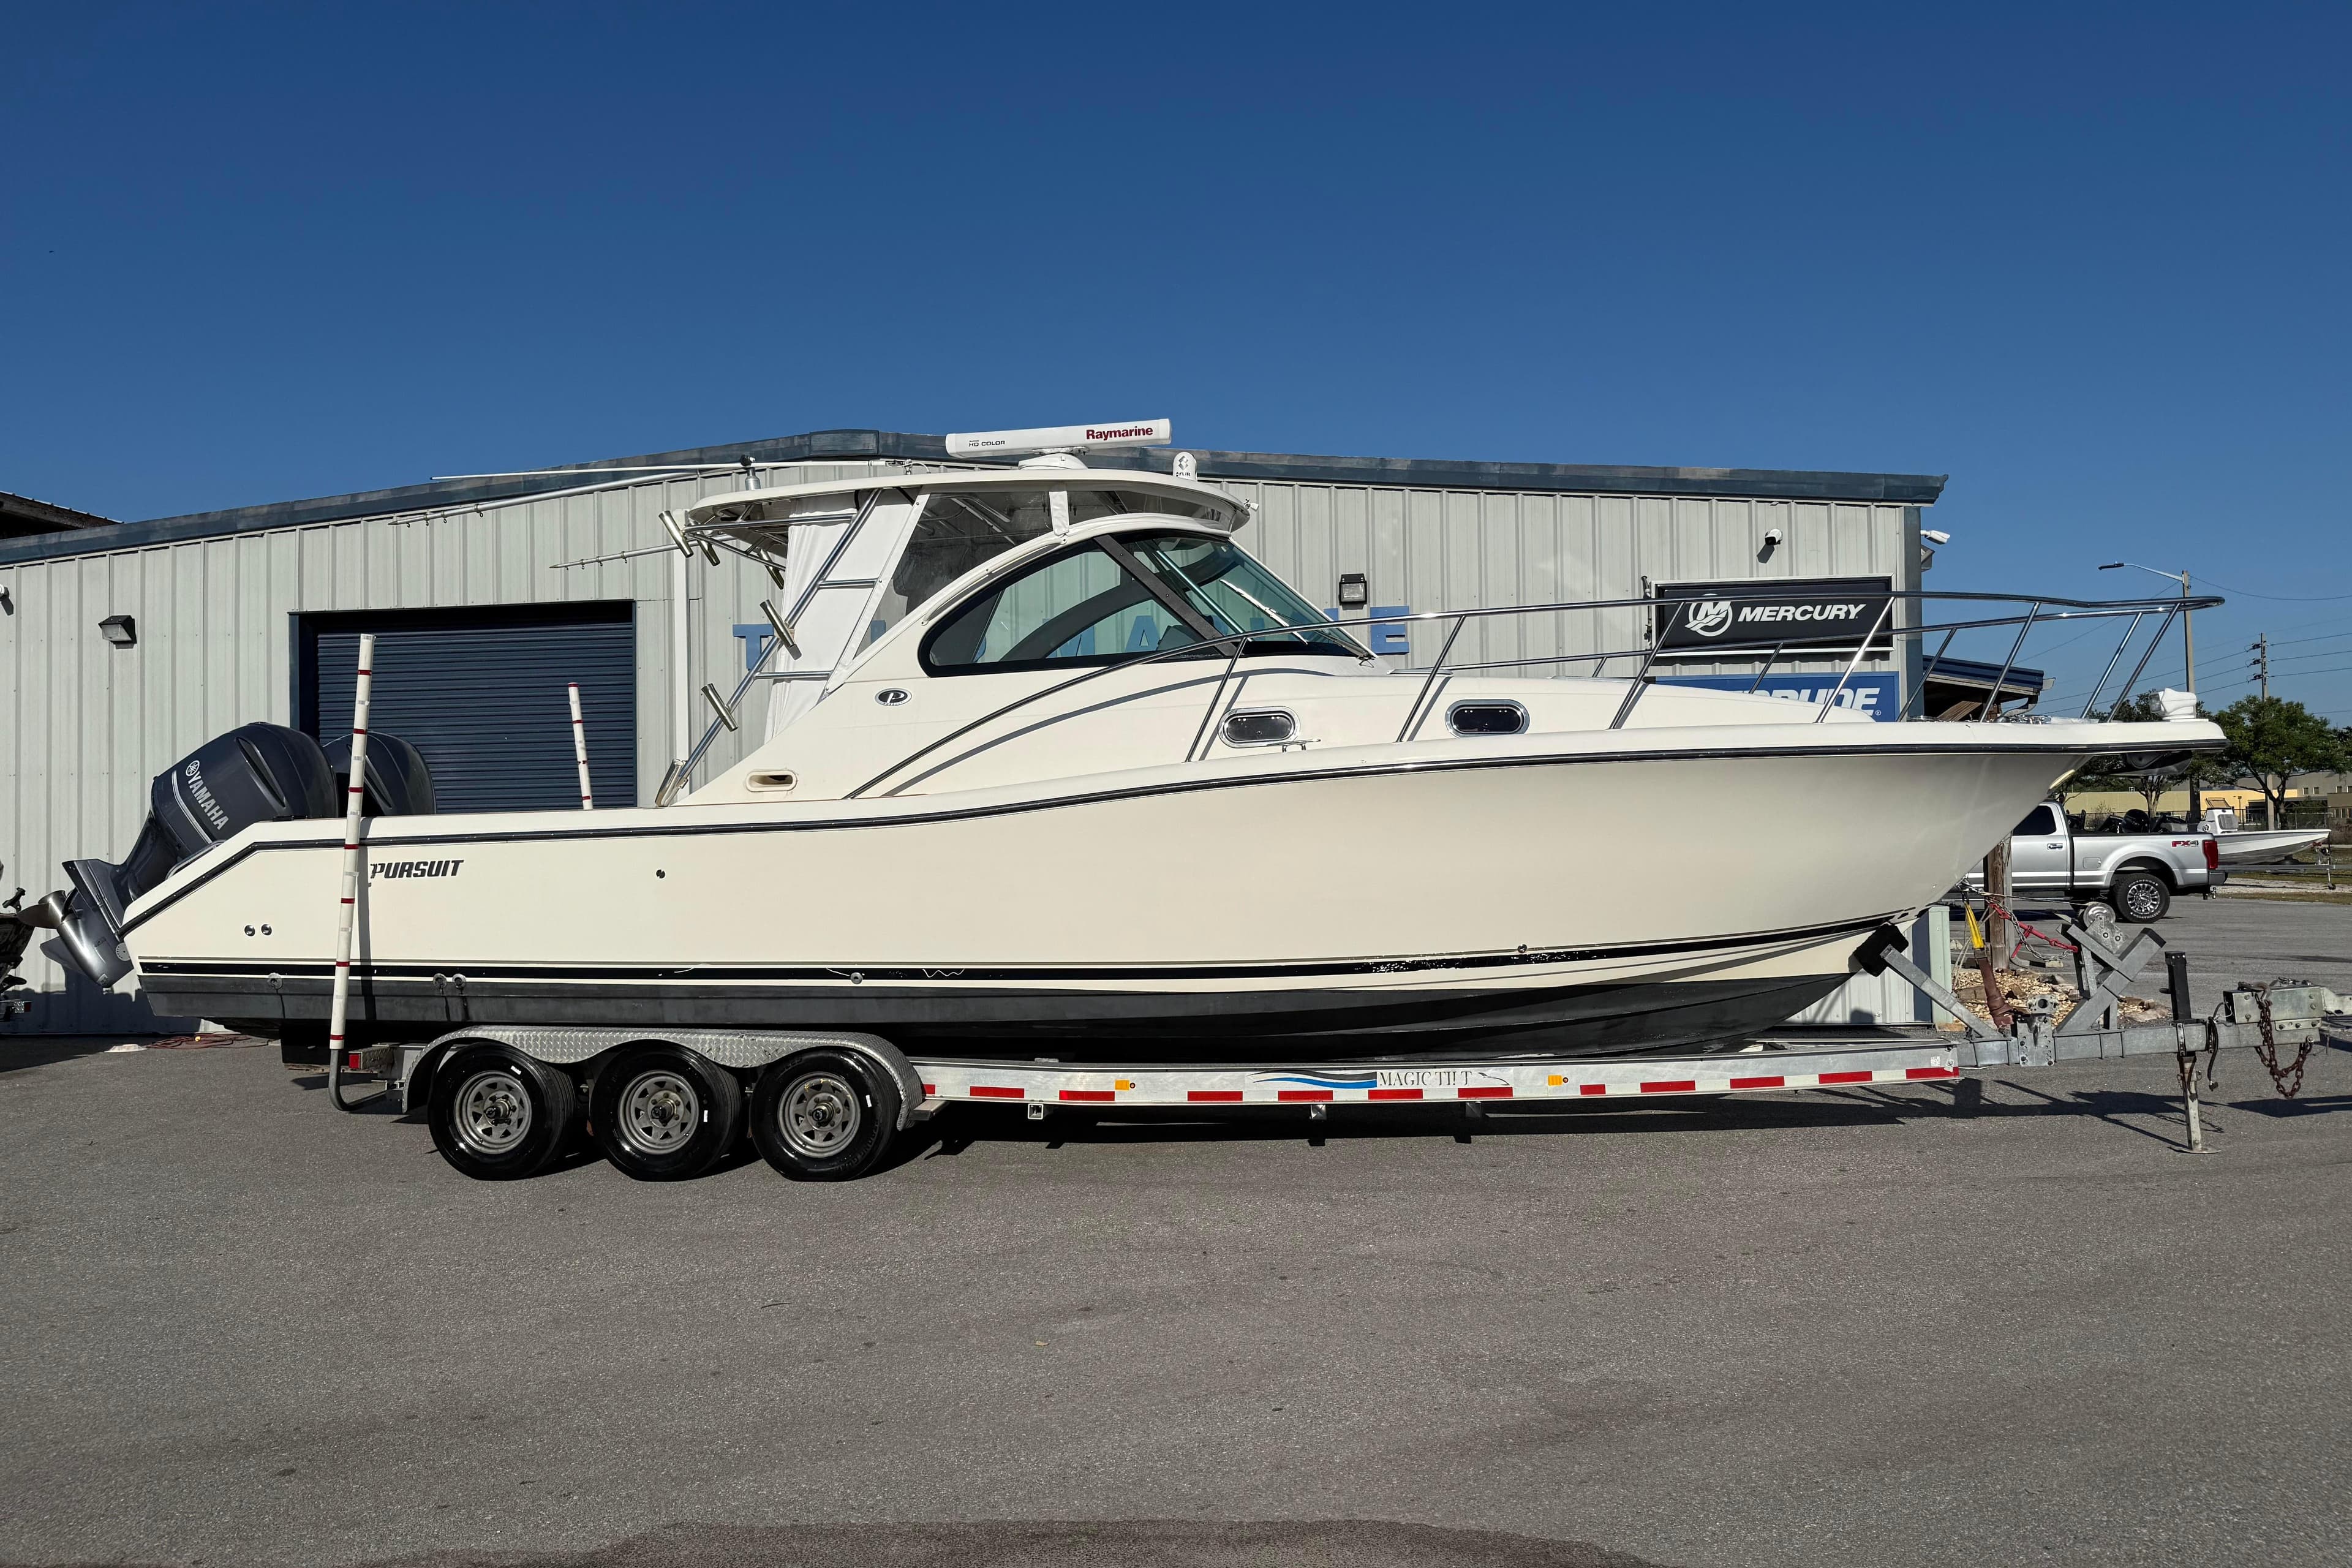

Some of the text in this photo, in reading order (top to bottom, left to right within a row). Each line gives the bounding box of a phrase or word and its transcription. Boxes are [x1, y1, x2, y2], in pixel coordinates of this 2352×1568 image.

[1086, 426, 1153, 441] Raymarine
[1737, 603, 1867, 622] MERCURY
[187, 770, 230, 831] YAMAHA
[370, 859, 464, 879] PURSUIT
[1379, 1071, 1431, 1086] MAGIC
